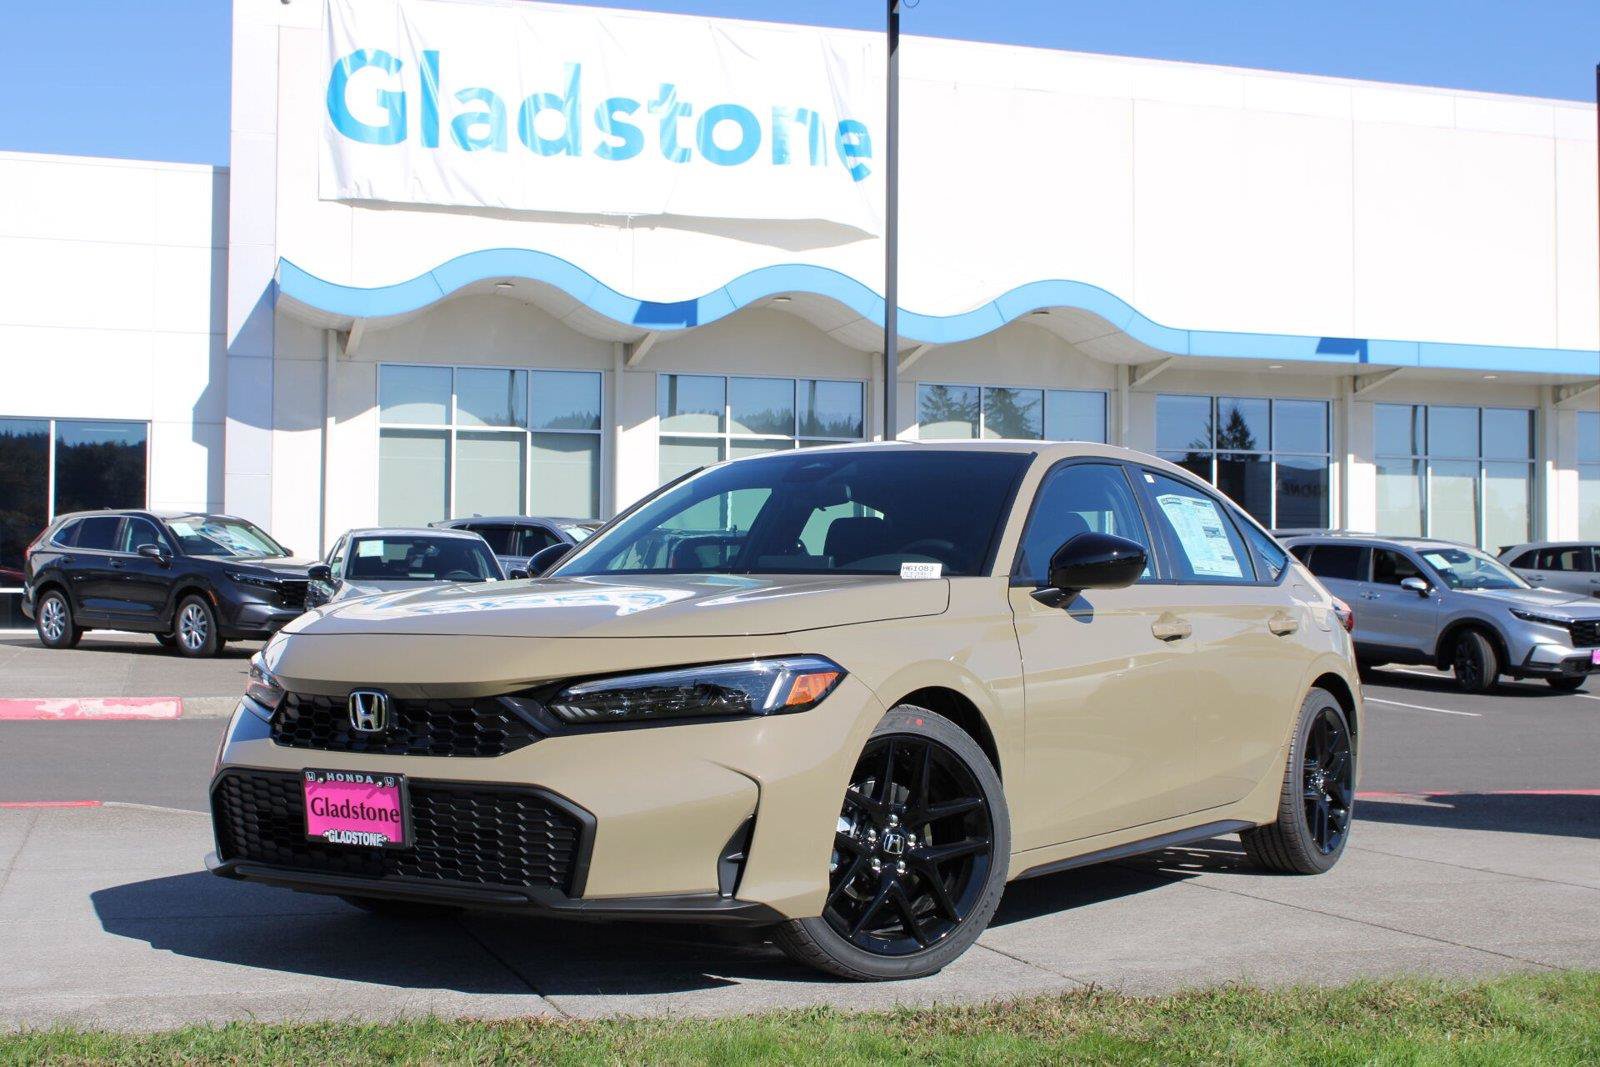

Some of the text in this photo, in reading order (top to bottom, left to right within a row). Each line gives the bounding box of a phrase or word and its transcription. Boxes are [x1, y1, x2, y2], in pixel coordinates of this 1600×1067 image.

[326, 48, 872, 182] Gladstone
[326, 772, 374, 784] HONDA
[310, 797, 400, 823] Gladstone
[328, 829, 383, 847] GLADSTONE
